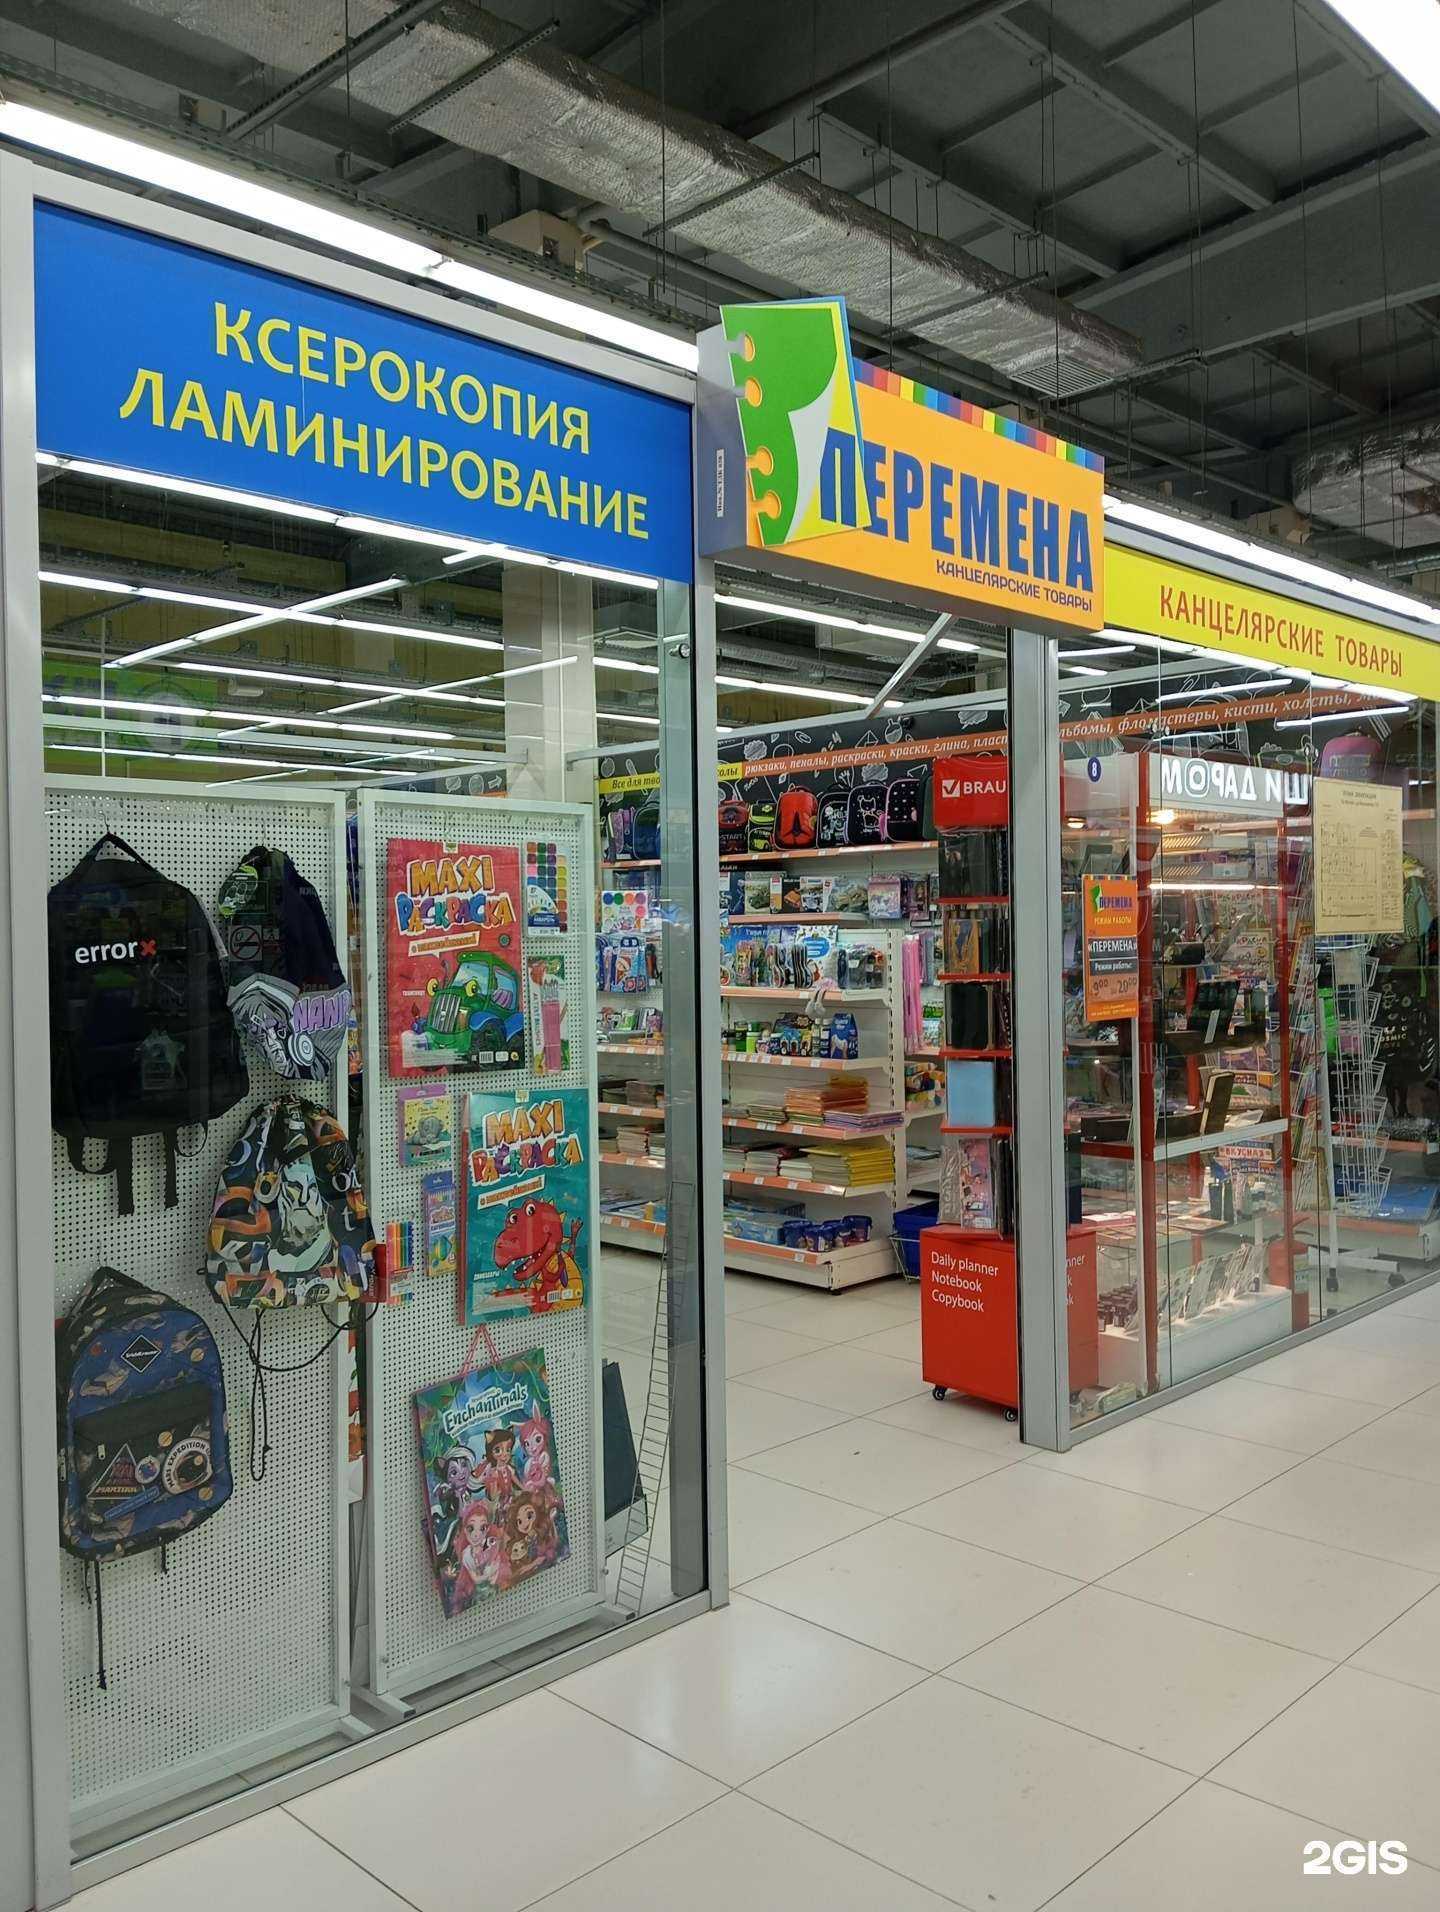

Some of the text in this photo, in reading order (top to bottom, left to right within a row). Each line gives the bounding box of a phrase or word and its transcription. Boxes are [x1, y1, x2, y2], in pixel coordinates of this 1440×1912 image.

[214, 301, 591, 455] КСЕРОКОПИЯ
[119, 367, 650, 541] ЛАМИНИРОВАНИЕ
[819, 426, 1094, 593] ПЕРЕМЕНА
[936, 559, 1093, 612] КАНЦЕЛЯРСКИЕ ТОВАРЫ
[1159, 585, 1404, 678] КАНЦЕЛЯРСКИЕ ТОВАРЫ
[1058, 723, 1115, 740] льбомы,
[1118, 707, 1219, 732] фломастеры,
[1224, 702, 1278, 720] кисти,
[1283, 692, 1352, 715] холсты,
[718, 767, 738, 777] олы
[745, 761, 787, 777] рюкзаки,
[831, 751, 888, 767] раскраски,
[889, 745, 931, 757] краски,
[934, 739, 971, 752] глина,
[612, 780, 625, 790] Все
[626, 777, 639, 788] для
[963, 780, 1007, 794] BRAU
[408, 856, 494, 897] MAXI
[396, 892, 516, 935] РАСКРАСКА
[1099, 895, 1132, 909] ПЕРЕМЕНА
[1088, 939, 1137, 953] «ПЕРЕМЕНА»
[484, 1099, 565, 1148] MAXI
[931, 1250, 998, 1278] Daily planner
[931, 1270, 982, 1293] Notebook
[931, 1289, 984, 1312] Copybook
[444, 1383, 527, 1432] Enchantimals
